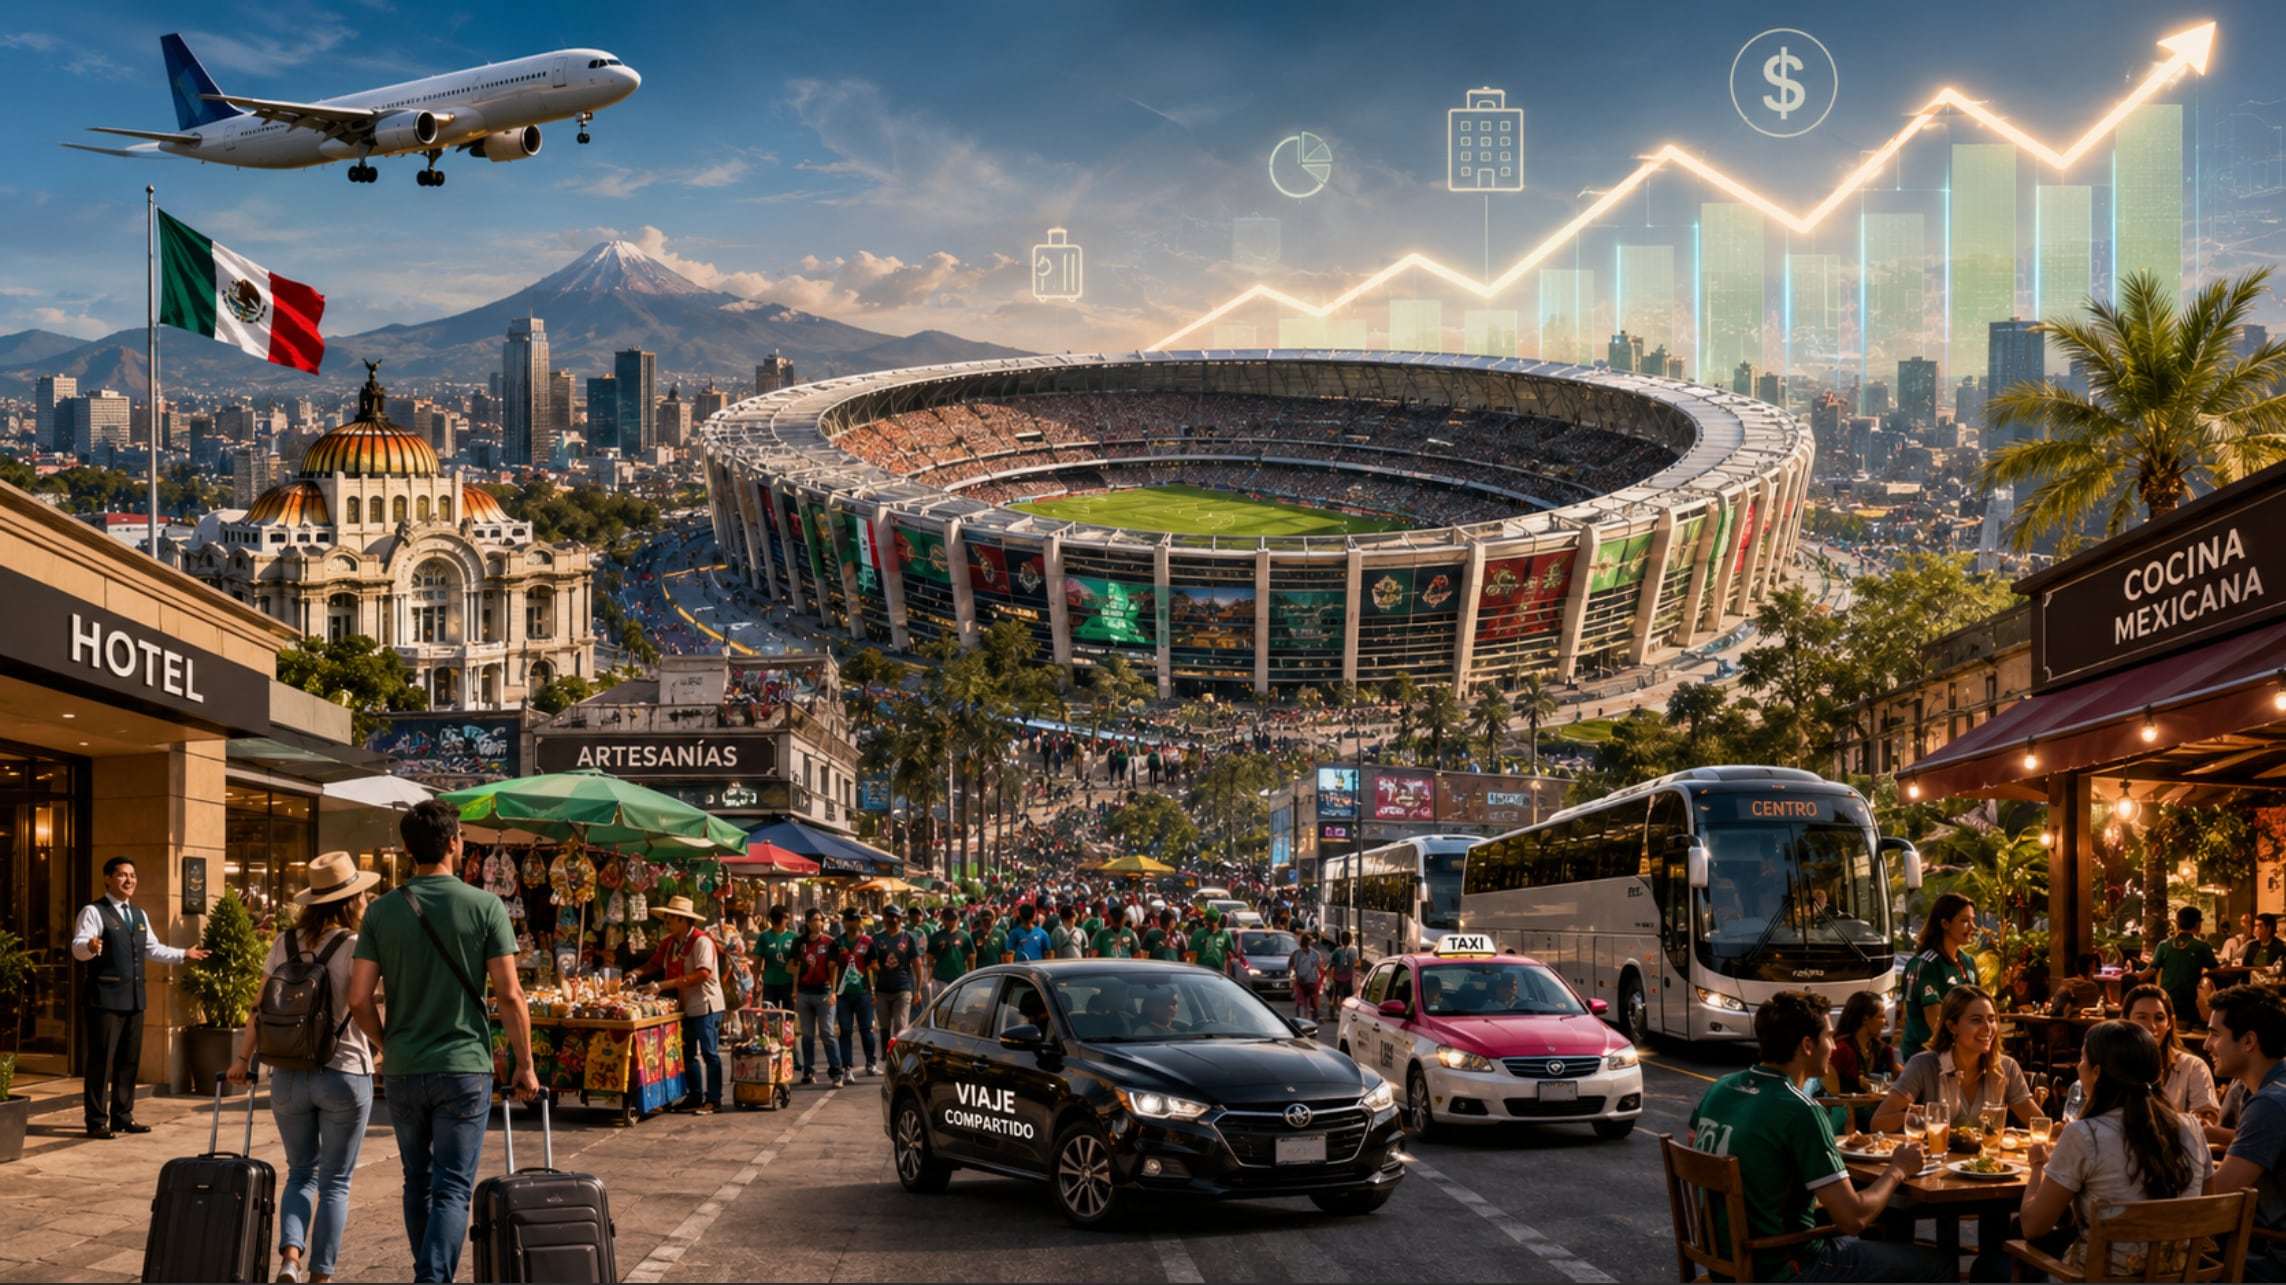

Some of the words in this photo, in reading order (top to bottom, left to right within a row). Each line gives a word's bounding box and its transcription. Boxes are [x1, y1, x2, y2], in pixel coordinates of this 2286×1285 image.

[2124, 528, 2246, 602] COCINA
[2114, 566, 2265, 645] MEXICANA
[71, 613, 204, 703] HOTEL
[576, 739, 738, 767] ARTESANÍAS
[1751, 800, 1818, 817] CENTRO
[1448, 937, 1484, 951] TAXI
[955, 1081, 1016, 1114] VIAJE
[944, 1108, 1034, 1140] COMPARTIDO
